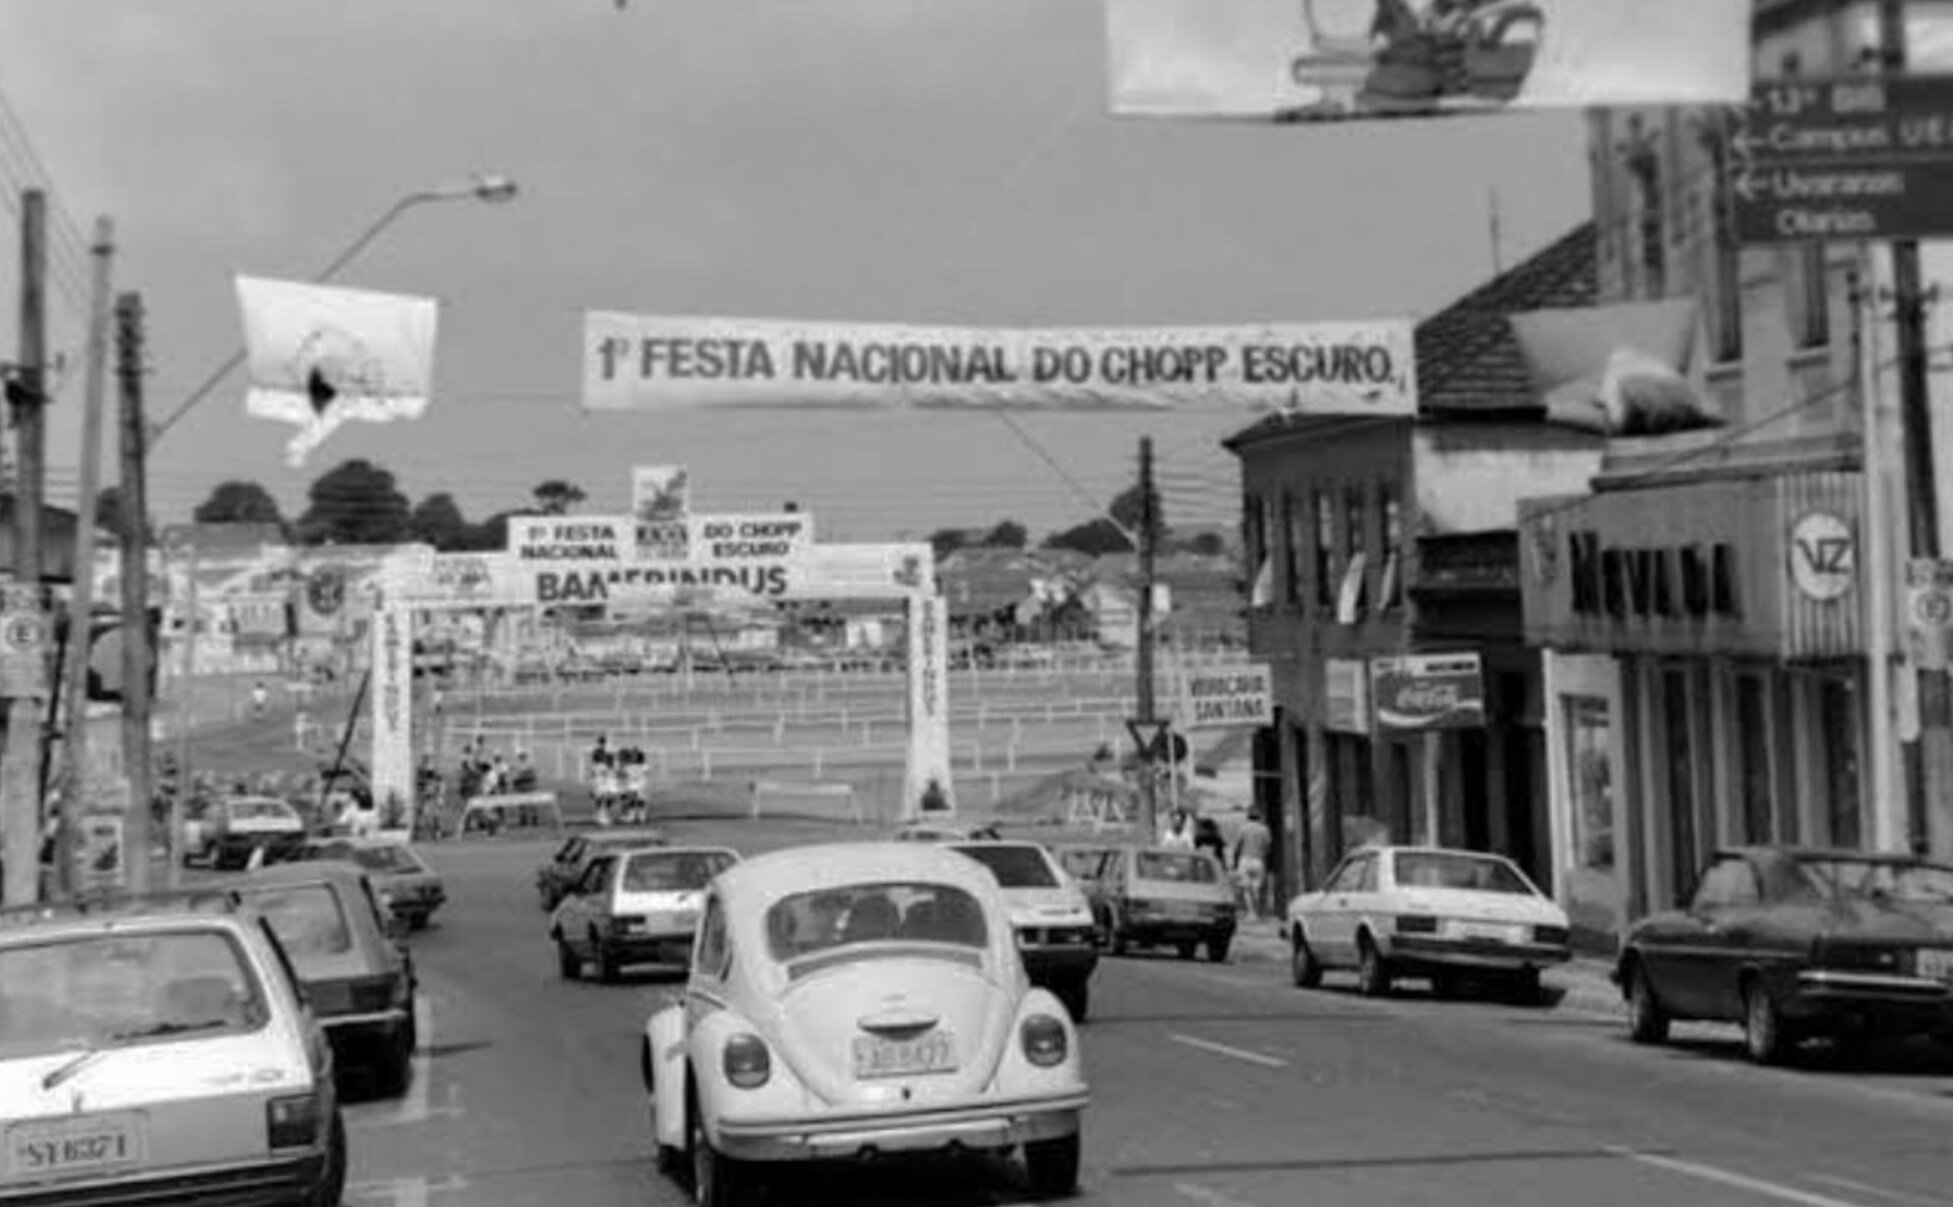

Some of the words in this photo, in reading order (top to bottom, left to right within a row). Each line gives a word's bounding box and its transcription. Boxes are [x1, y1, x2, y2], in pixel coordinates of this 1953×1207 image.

[640, 338, 774, 380] FESTA
[792, 341, 1017, 384] NACIONAL
[1032, 346, 1092, 384] DO
[1101, 345, 1229, 384] CHOPP
[555, 525, 615, 540] FESTA
[704, 523, 732, 539] DO
[739, 522, 802, 538] CHOPP
[521, 544, 618, 560] NACIONAL
[713, 542, 789, 558] ESCURO
